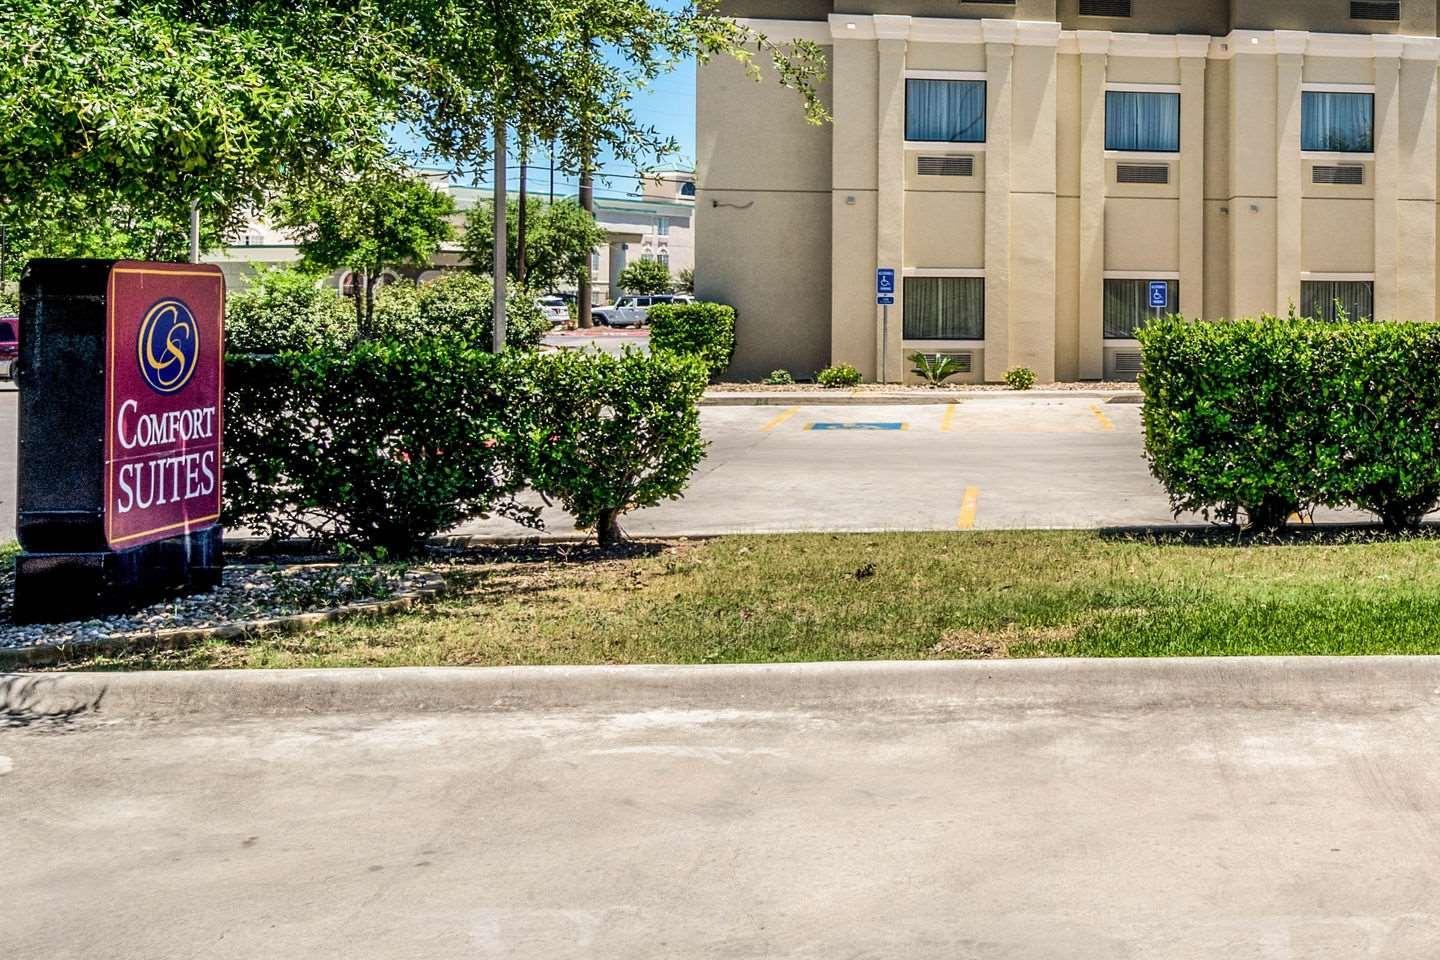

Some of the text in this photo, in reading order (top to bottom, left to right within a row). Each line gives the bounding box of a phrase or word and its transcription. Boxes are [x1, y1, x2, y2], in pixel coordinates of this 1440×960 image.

[146, 305, 190, 386] CS
[117, 399, 215, 449] COMFORT
[118, 450, 214, 513] SUITES
